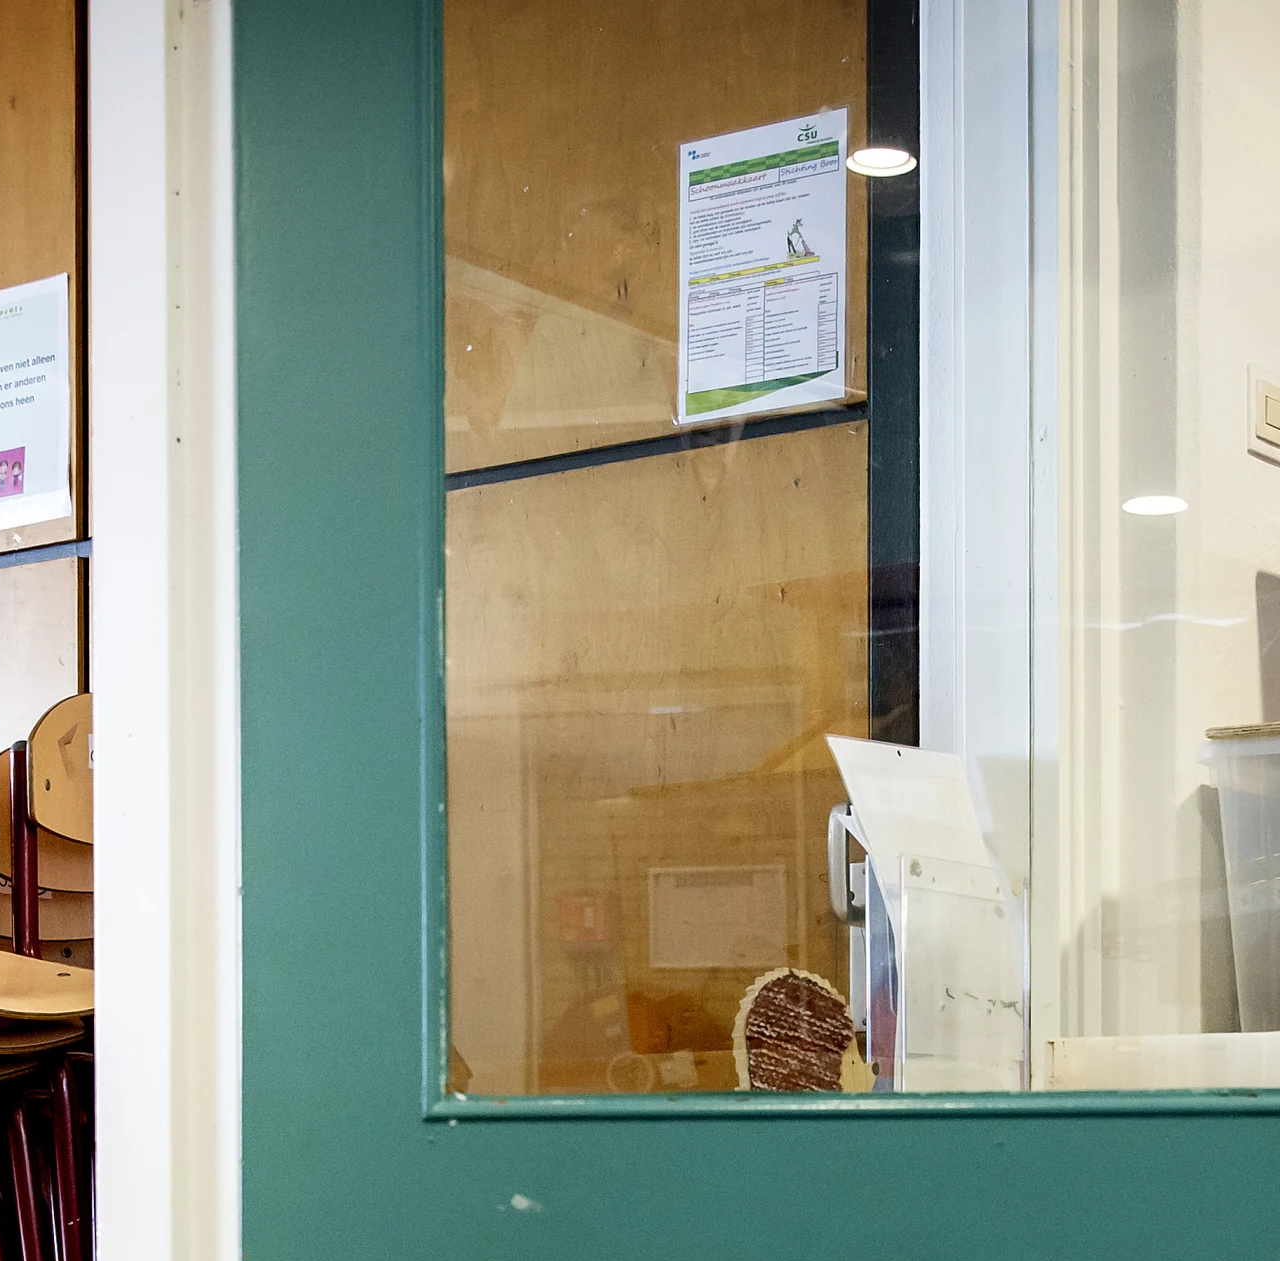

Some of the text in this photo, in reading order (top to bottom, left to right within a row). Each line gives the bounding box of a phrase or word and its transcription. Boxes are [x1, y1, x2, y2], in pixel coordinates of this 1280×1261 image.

[797, 130, 818, 142] CSU
[780, 162, 817, 177] Stichting
[690, 172, 768, 196] Schoonmaakkaart
[15, 358, 30, 370] niet
[31, 353, 56, 367] alleen
[4, 381, 13, 391] er
[14, 374, 47, 388] anderen
[0, 400, 14, 410] ons
[15, 395, 35, 406] heen
